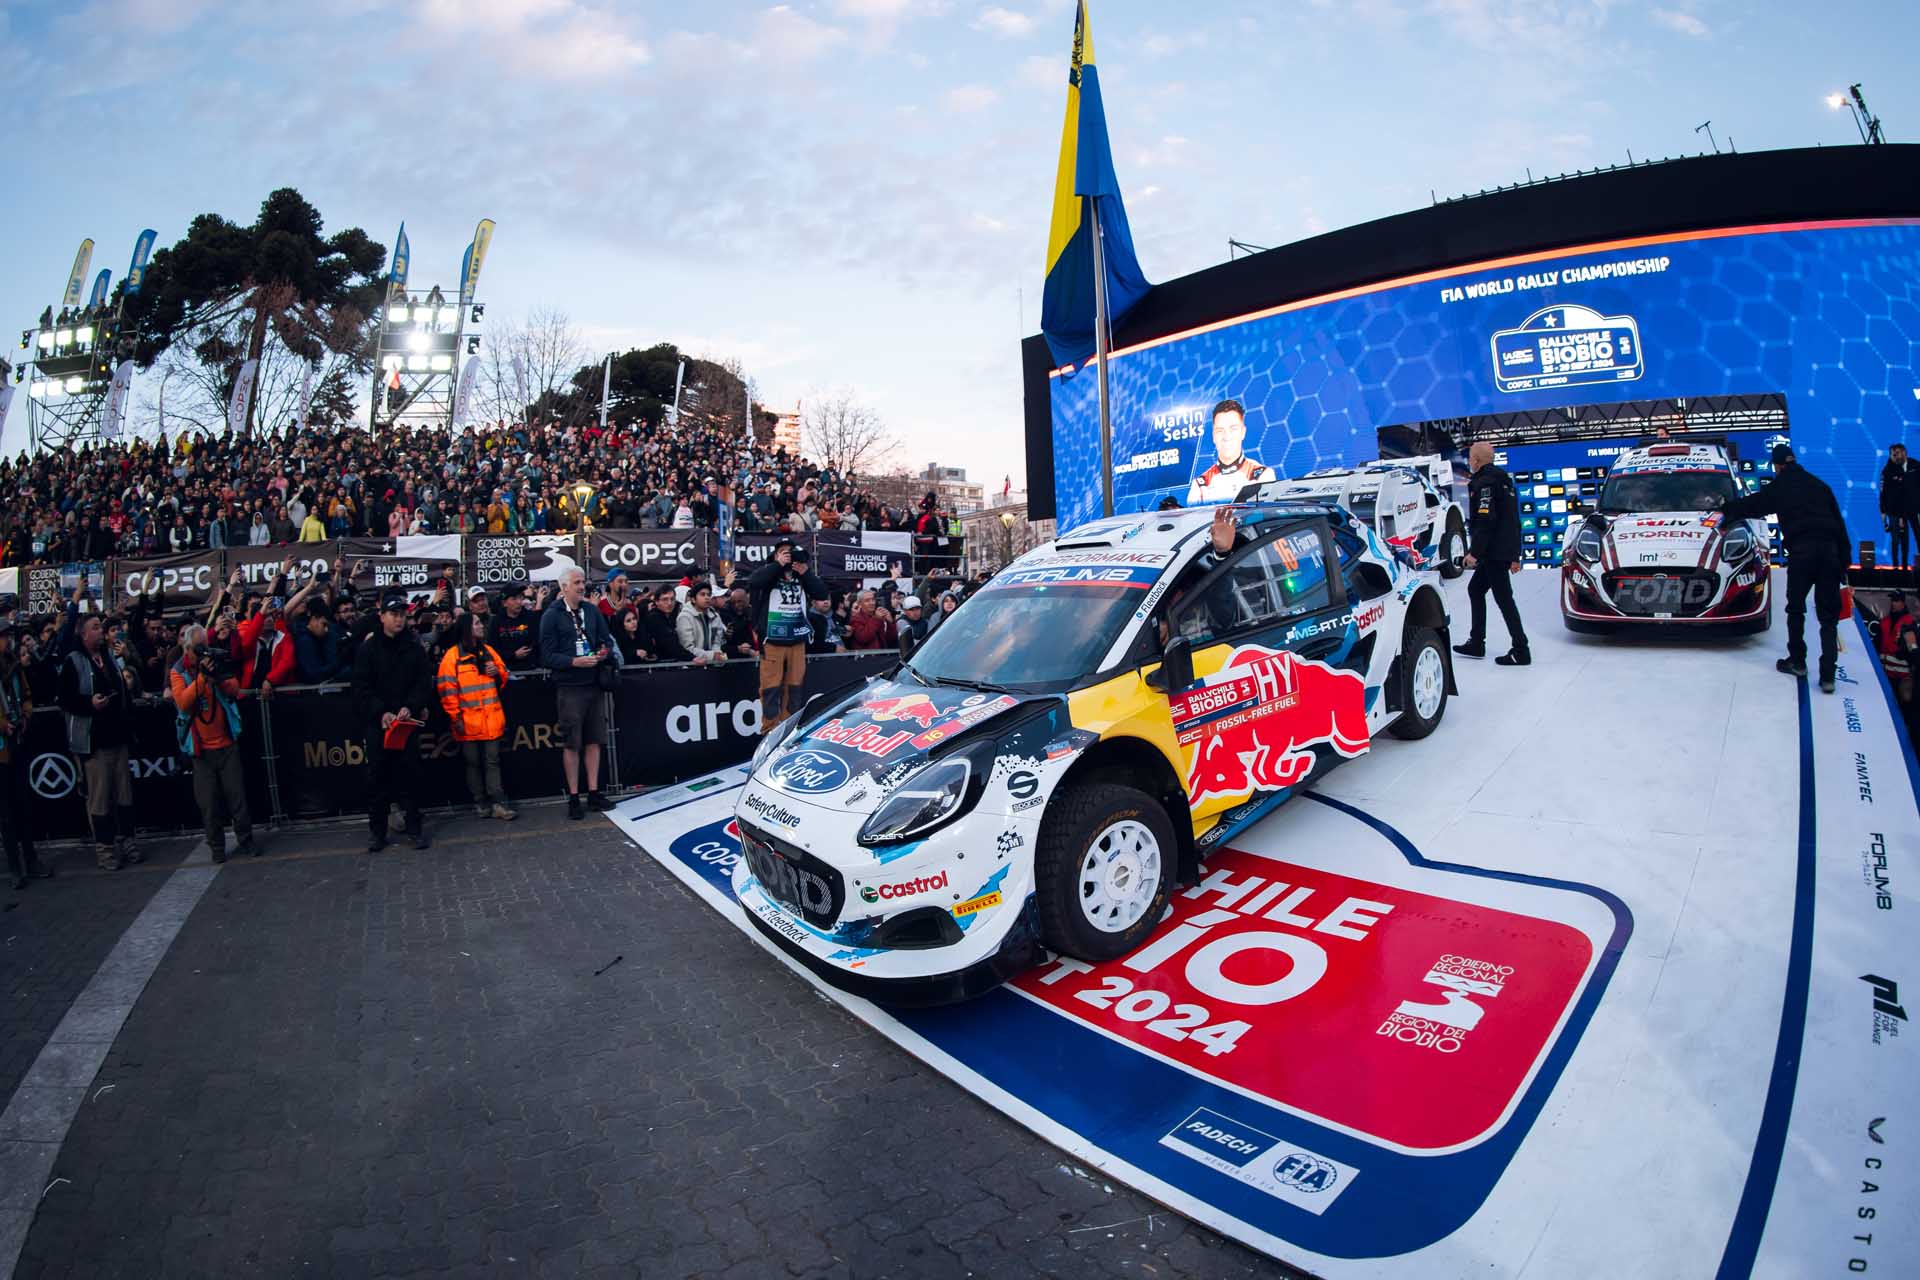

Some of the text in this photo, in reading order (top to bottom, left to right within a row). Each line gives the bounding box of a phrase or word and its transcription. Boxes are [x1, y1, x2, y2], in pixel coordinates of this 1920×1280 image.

[1441, 257, 1670, 303] FIA WORLD RALLY CHAMPIONSHIP
[1538, 331, 1611, 348] RALLYCHILE
[1154, 411, 1204, 430] Martin
[1164, 425, 1205, 442] Sesks
[477, 537, 526, 549] GOBIERNO
[1618, 530, 1705, 540] STORENT
[375, 563, 428, 574] RALLYCHILE
[477, 548, 526, 560] REGIONAL
[478, 558, 525, 568] REGION DEL
[600, 543, 695, 566] COPEC
[845, 554, 887, 563] RALLYCHILE
[1042, 552, 1168, 565] PERFORMANCE
[125, 565, 212, 597] COPEC
[1007, 569, 1134, 583] FORUM8
[1140, 581, 1168, 614] Fleetback
[1614, 579, 1711, 605] FORD
[1252, 653, 1292, 702] HY
[1188, 683, 1235, 703] RALLYCHILE
[665, 698, 763, 744] ara
[1215, 696, 1296, 732] FOSSIL-FREE FUEL
[922, 729, 944, 742] 16
[776, 753, 837, 788] Ford
[1854, 752, 1873, 803] FANATEC
[745, 793, 801, 827] SafetyCulture
[879, 870, 949, 899] Castrol
[1870, 832, 1892, 910] FORUM8
[956, 893, 998, 916] PIRELLI
[1182, 868, 1396, 942] HILE
[767, 910, 810, 943] Fleetback
[1432, 961, 1507, 985] REGIONAL
[1440, 953, 1514, 976] GOBIERNO
[1074, 976, 1254, 1057] 2024
[1387, 1012, 1467, 1041] REGION DEL
[1872, 1010, 1881, 1046] CHANGE
[1376, 1021, 1461, 1053] BIOBIO
[1186, 1121, 1259, 1155] FADECH
[1848, 1157, 1882, 1273] CASTO
